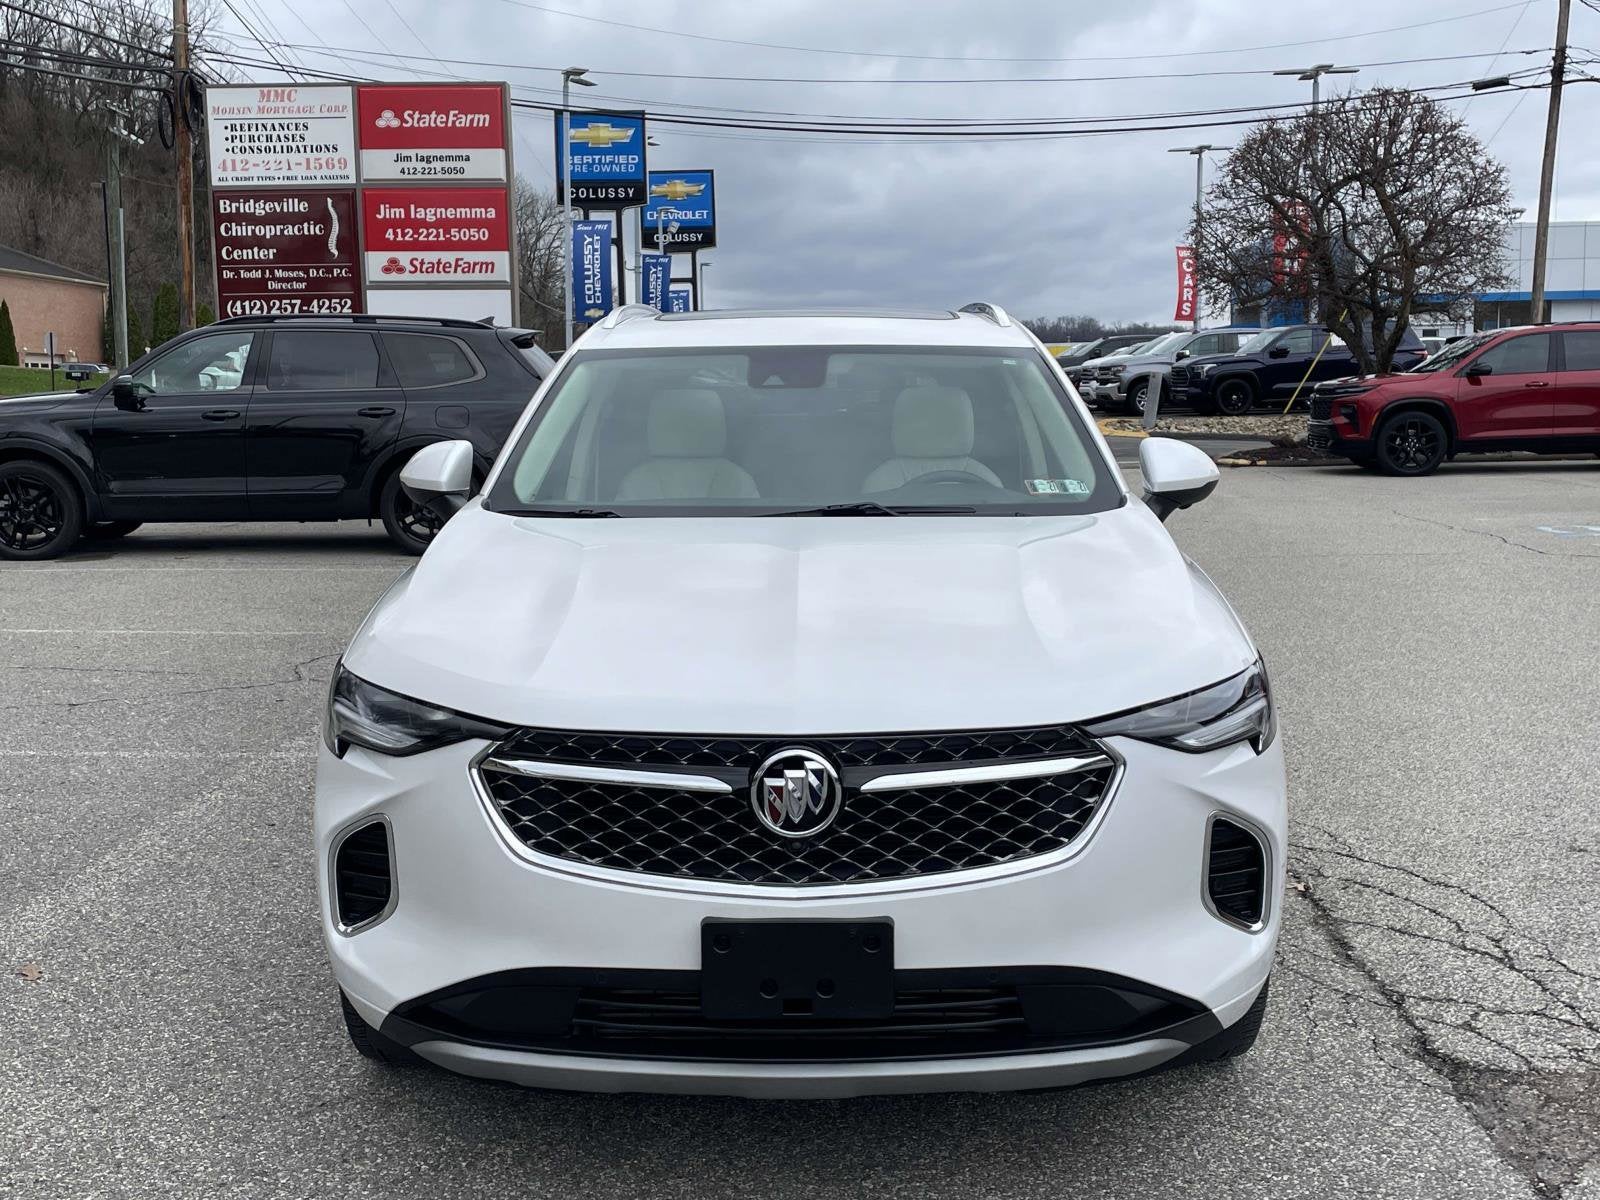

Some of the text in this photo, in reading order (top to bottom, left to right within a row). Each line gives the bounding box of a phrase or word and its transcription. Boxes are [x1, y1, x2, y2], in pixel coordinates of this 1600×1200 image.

[258, 89, 297, 103] MMC
[257, 105, 315, 115] MORTGAGE
[230, 122, 309, 132] REFINANCES
[231, 134, 306, 143] PURCHASES
[232, 144, 338, 154] CONSOLIDATIONS
[394, 153, 471, 164] Jim Iagnemma
[218, 158, 348, 172] 412-221-1569
[400, 167, 465, 175] 412-221-5050
[570, 188, 635, 198] COLUSSY
[219, 198, 309, 216] Bridgeville
[376, 204, 496, 222] Jim Iagnemma
[647, 210, 708, 219] CHEVROLET
[220, 221, 325, 238] Chiropractic
[385, 228, 489, 241] 412-221-5050
[654, 233, 703, 242] COLUSSY
[221, 246, 277, 260] Center
[223, 270, 237, 279] Dr.
[239, 270, 262, 278] Todd
[264, 269, 272, 278] J.
[274, 269, 307, 279] Moses,
[333, 268, 352, 277] P.C.
[584, 234, 593, 304] COLUSSY
[268, 281, 307, 290] Director
[1181, 259, 1193, 315] CARS
